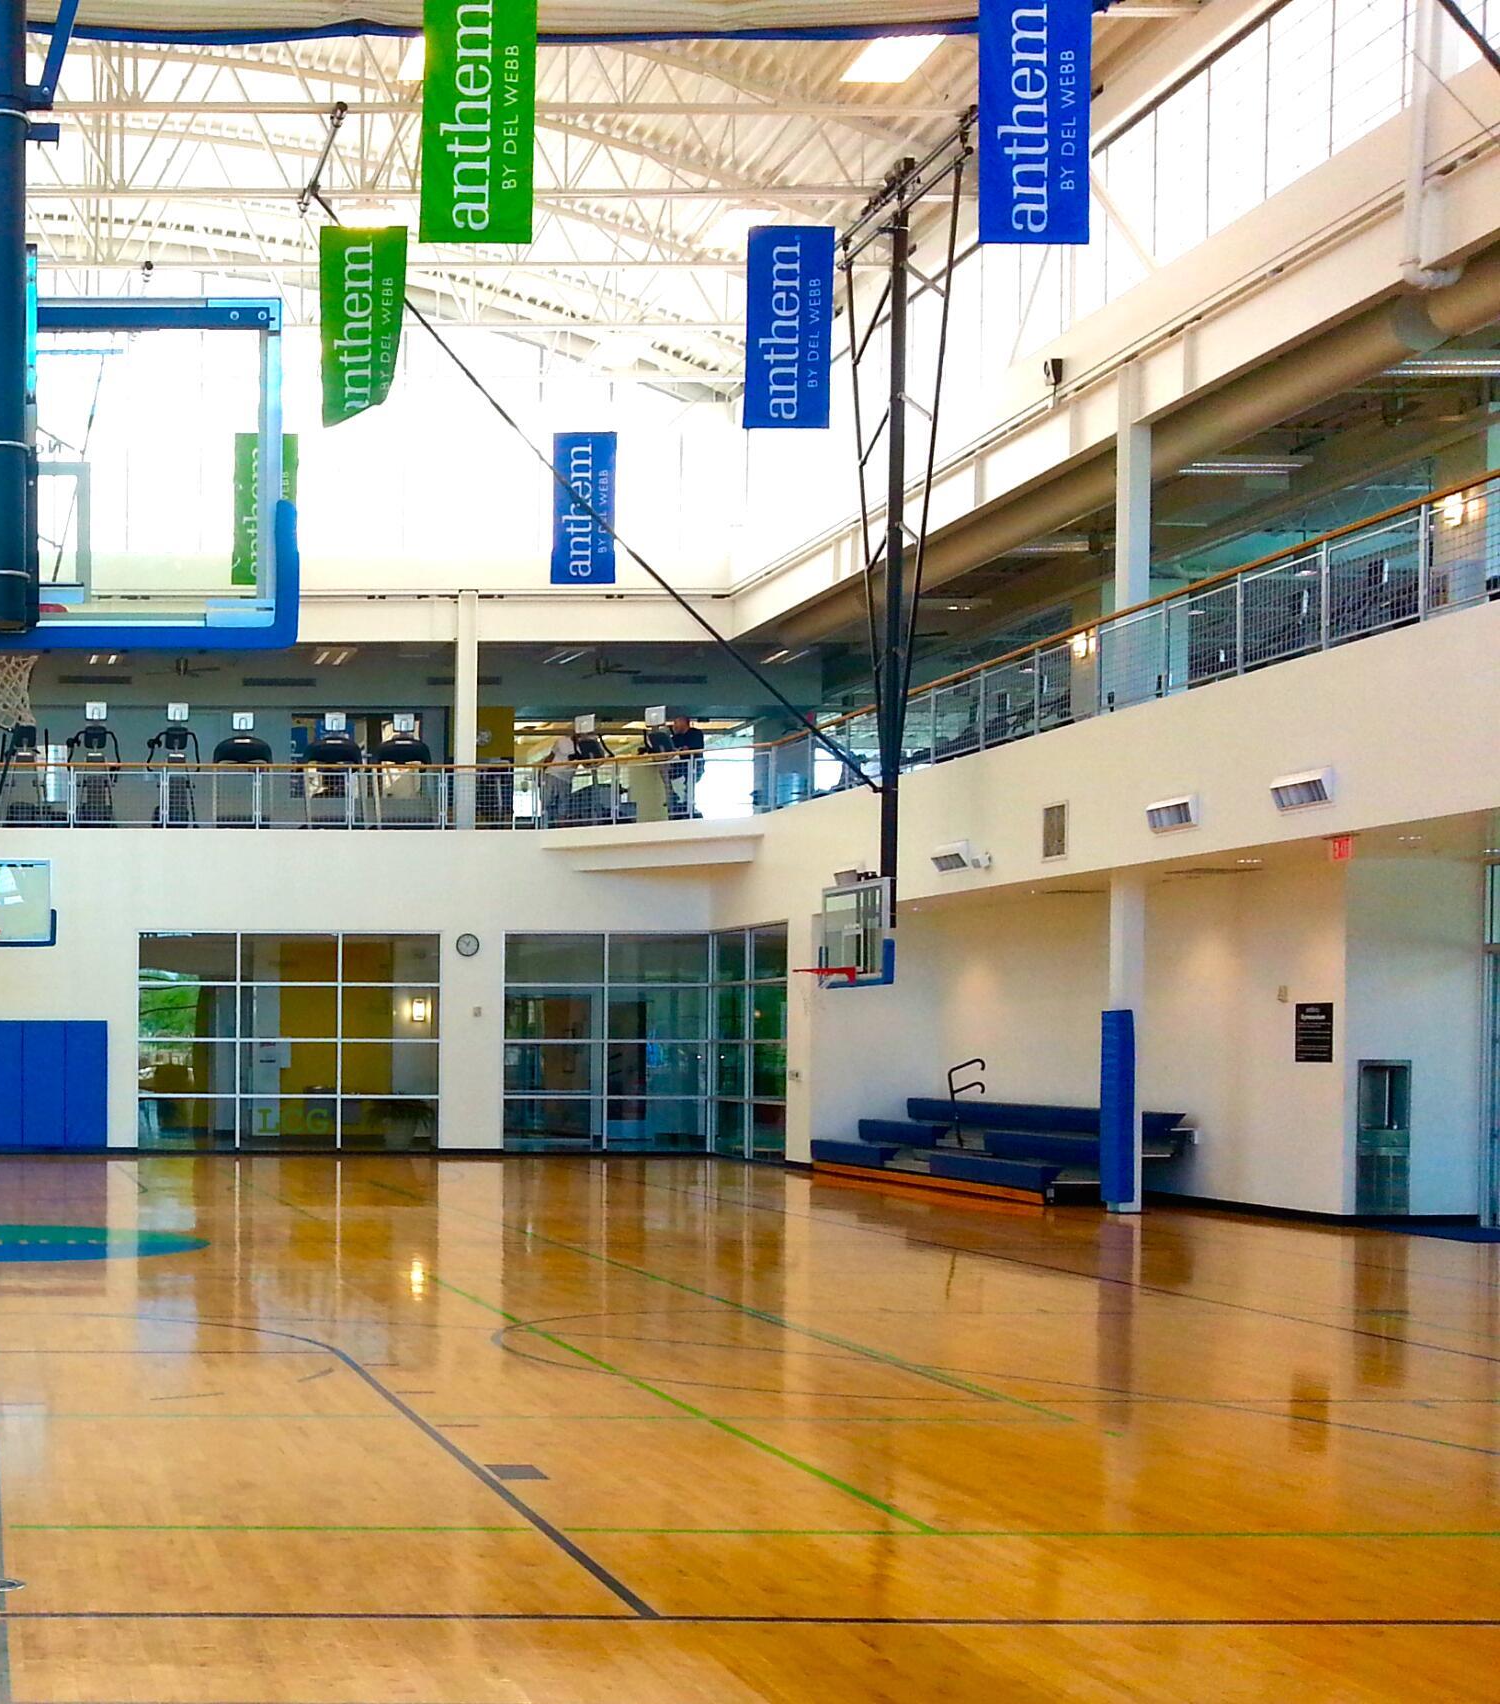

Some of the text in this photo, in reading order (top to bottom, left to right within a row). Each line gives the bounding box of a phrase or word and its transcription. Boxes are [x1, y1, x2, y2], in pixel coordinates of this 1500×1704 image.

[439, 0, 493, 231] anthem
[501, 45, 519, 190] BY DEL WEBB
[997, 3, 1049, 233] anthem
[1060, 50, 1077, 190] BY DEL WEBB
[380, 332, 391, 362] DEL
[382, 277, 394, 325] WEBB
[759, 240, 801, 420] anthem
[807, 278, 821, 388] BY DEL WEBB
[598, 469, 609, 508] WEBB
[598, 538, 607, 554] BY
